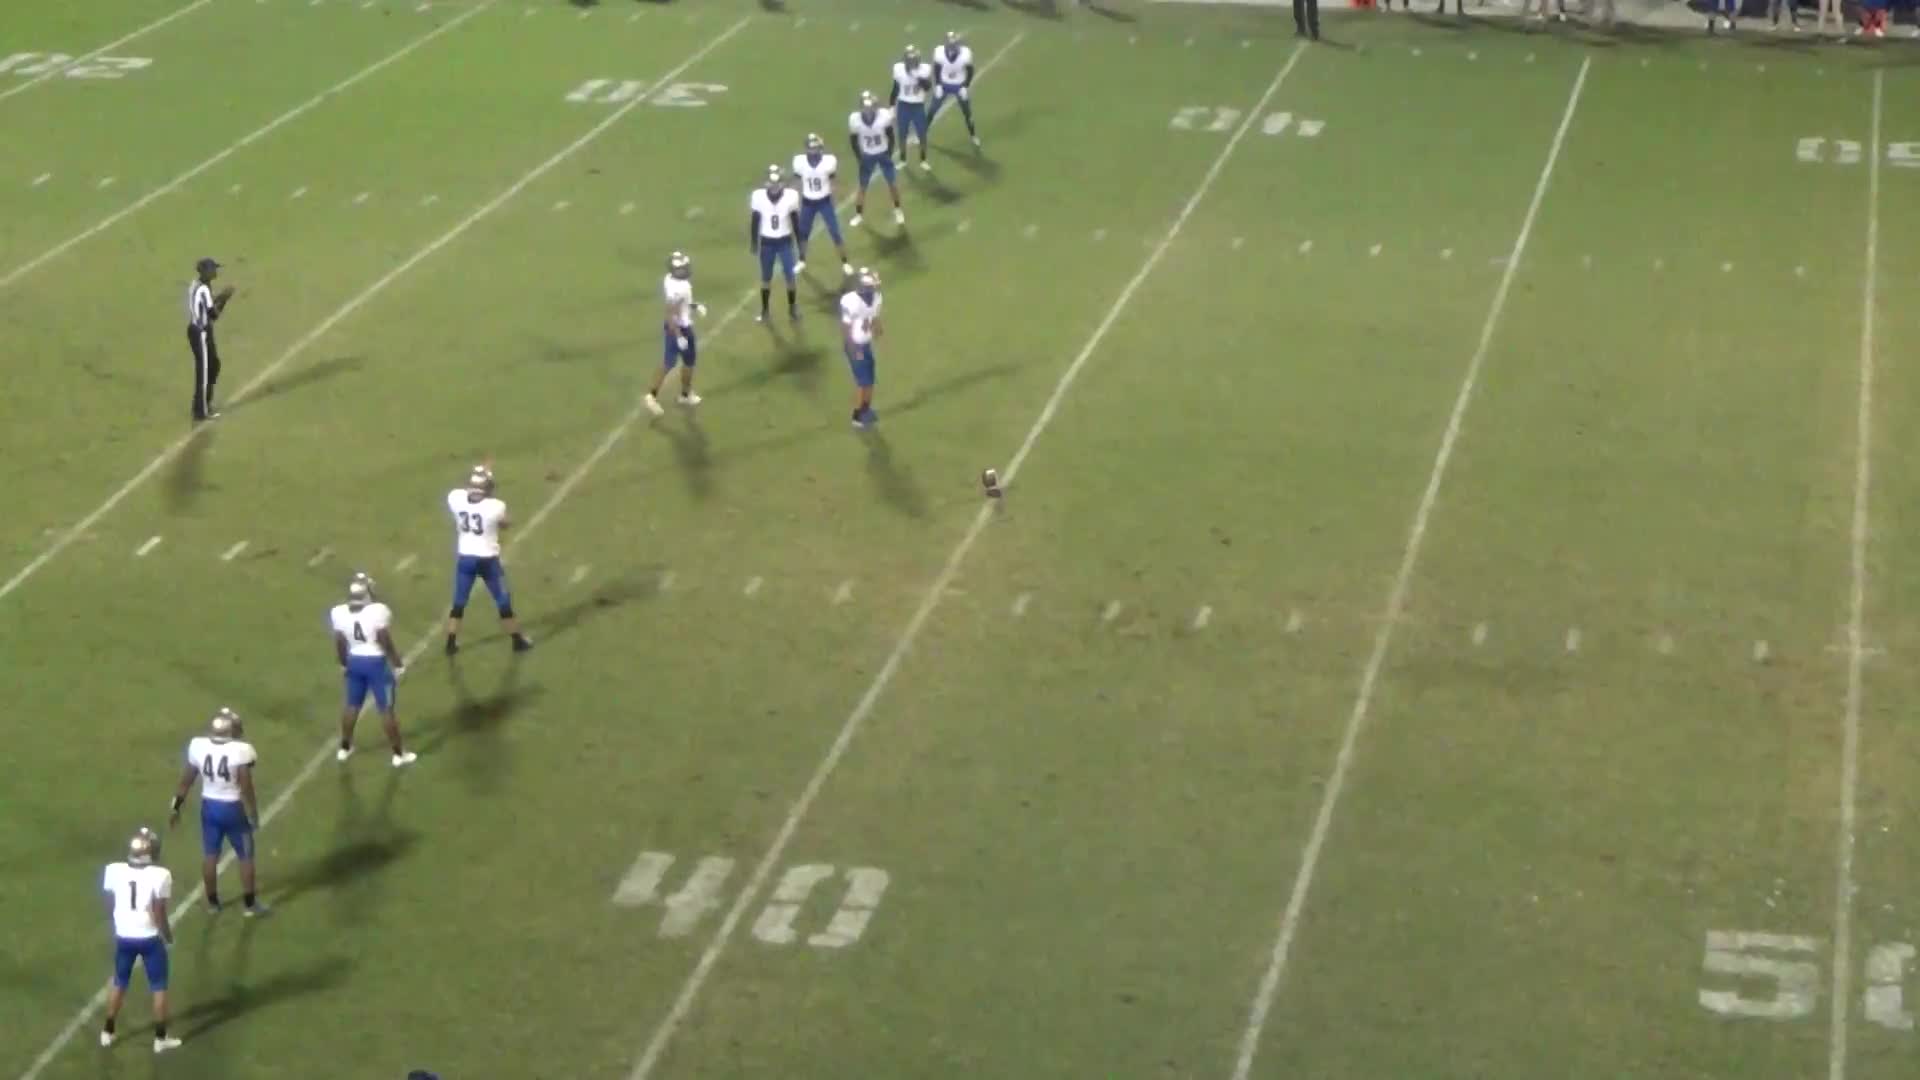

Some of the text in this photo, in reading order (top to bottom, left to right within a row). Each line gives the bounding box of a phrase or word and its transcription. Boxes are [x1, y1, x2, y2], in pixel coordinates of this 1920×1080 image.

[1171, 107, 1326, 137] 40
[459, 511, 484, 536] 33
[354, 621, 367, 643] 4
[203, 754, 230, 782] 44
[128, 880, 137, 911] 1
[611, 851, 889, 948] 40
